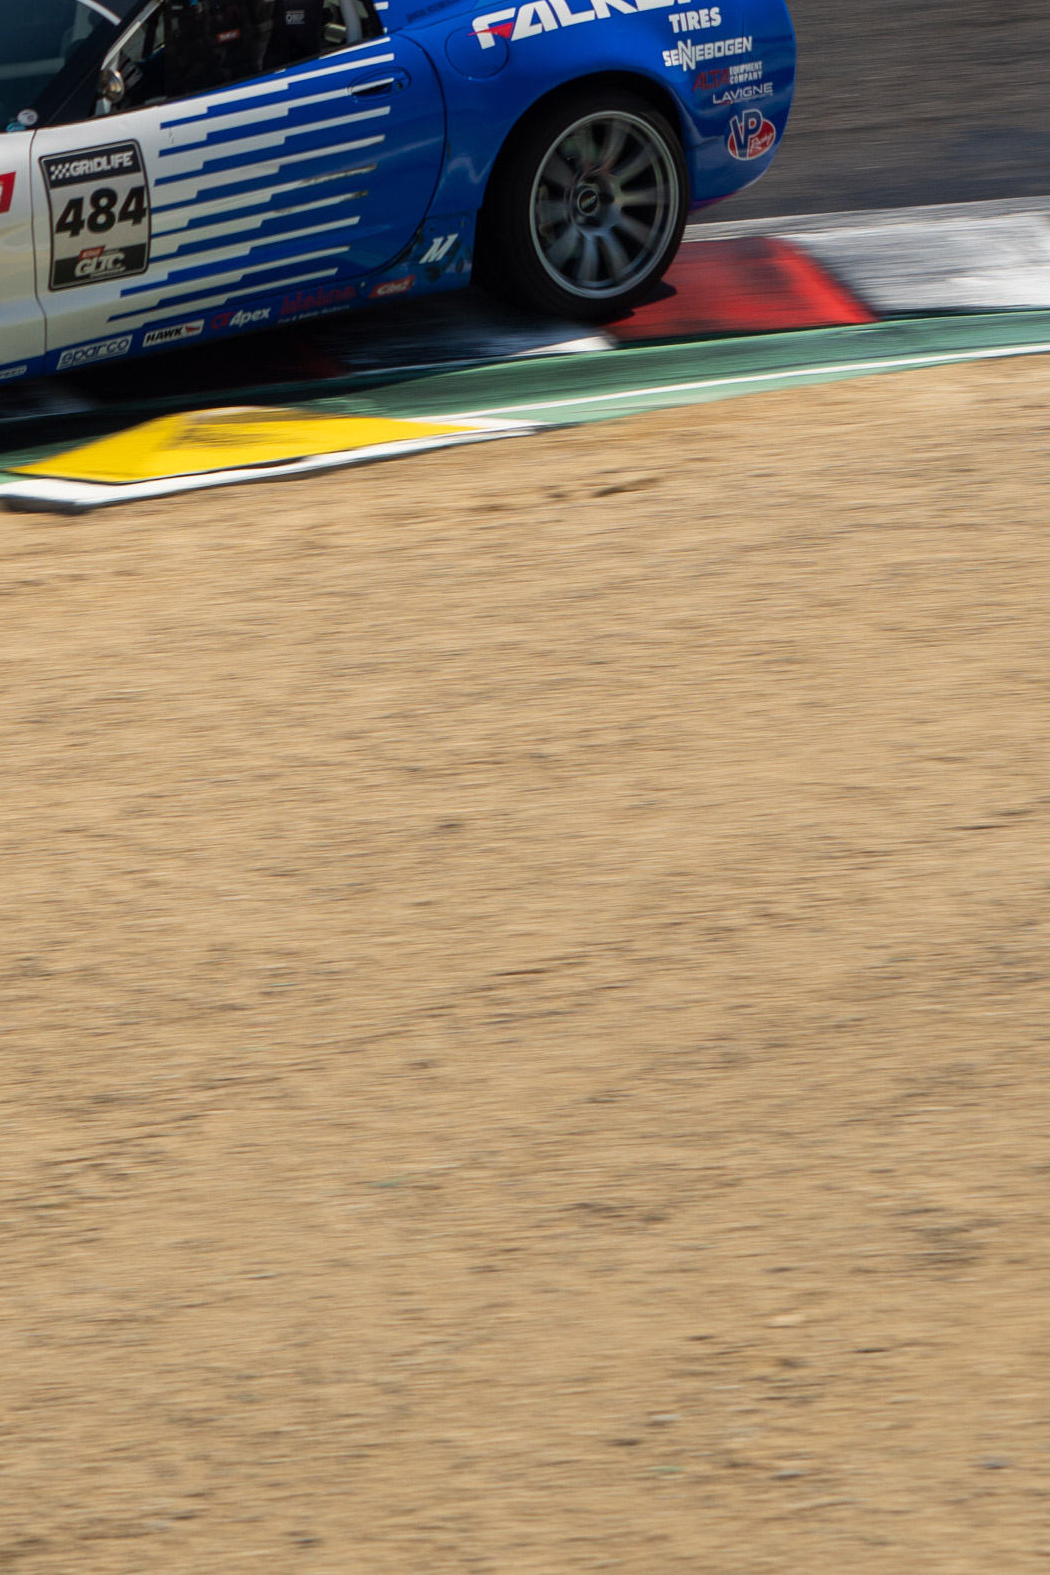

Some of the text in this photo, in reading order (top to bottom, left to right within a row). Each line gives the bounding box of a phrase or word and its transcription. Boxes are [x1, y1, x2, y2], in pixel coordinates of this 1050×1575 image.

[668, 7, 722, 33] TIRES
[692, 61, 763, 92] ALTA EQUIPMENT
[729, 70, 763, 85] COMPANY
[712, 82, 773, 105] LAVIGNE
[729, 108, 763, 160] VP
[70, 149, 134, 176] GRIDLIFE
[54, 185, 147, 239] 484
[146, 326, 184, 343] HAWK
[61, 338, 129, 367] sparco
